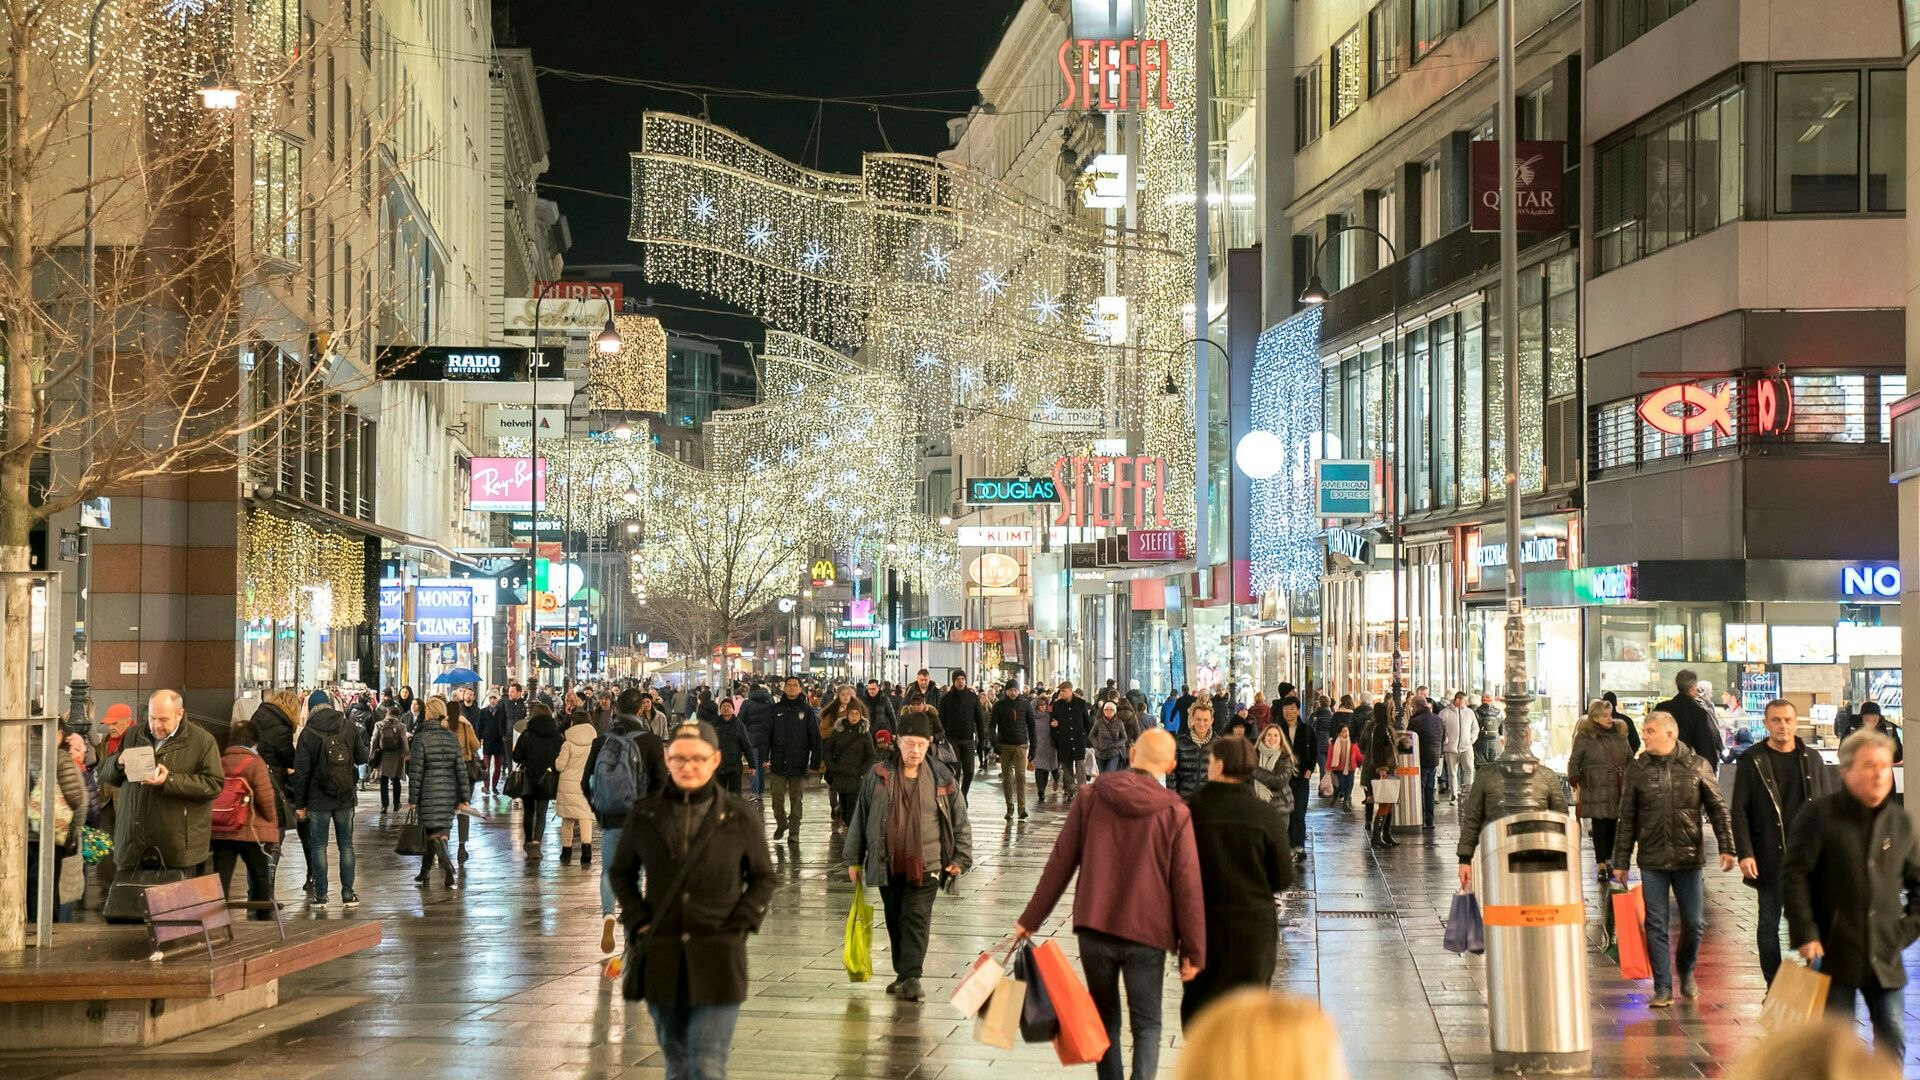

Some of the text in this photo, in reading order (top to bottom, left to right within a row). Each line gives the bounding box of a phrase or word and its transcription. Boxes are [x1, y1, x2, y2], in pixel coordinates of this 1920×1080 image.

[1058, 38, 1175, 110] STEFFL
[1482, 190, 1554, 211] QTAR
[447, 354, 501, 368] RADO
[500, 419, 534, 429] helveti
[973, 480, 1055, 501] DOUGLAS
[1052, 455, 1171, 528] STEFFL
[1321, 480, 1367, 490] AMERICAN
[1330, 490, 1370, 499] EXPRESS
[987, 531, 1031, 543] KLIMT
[1139, 532, 1174, 551] STEFFL
[417, 590, 472, 607] MONEY
[416, 617, 471, 636] CHANGE
